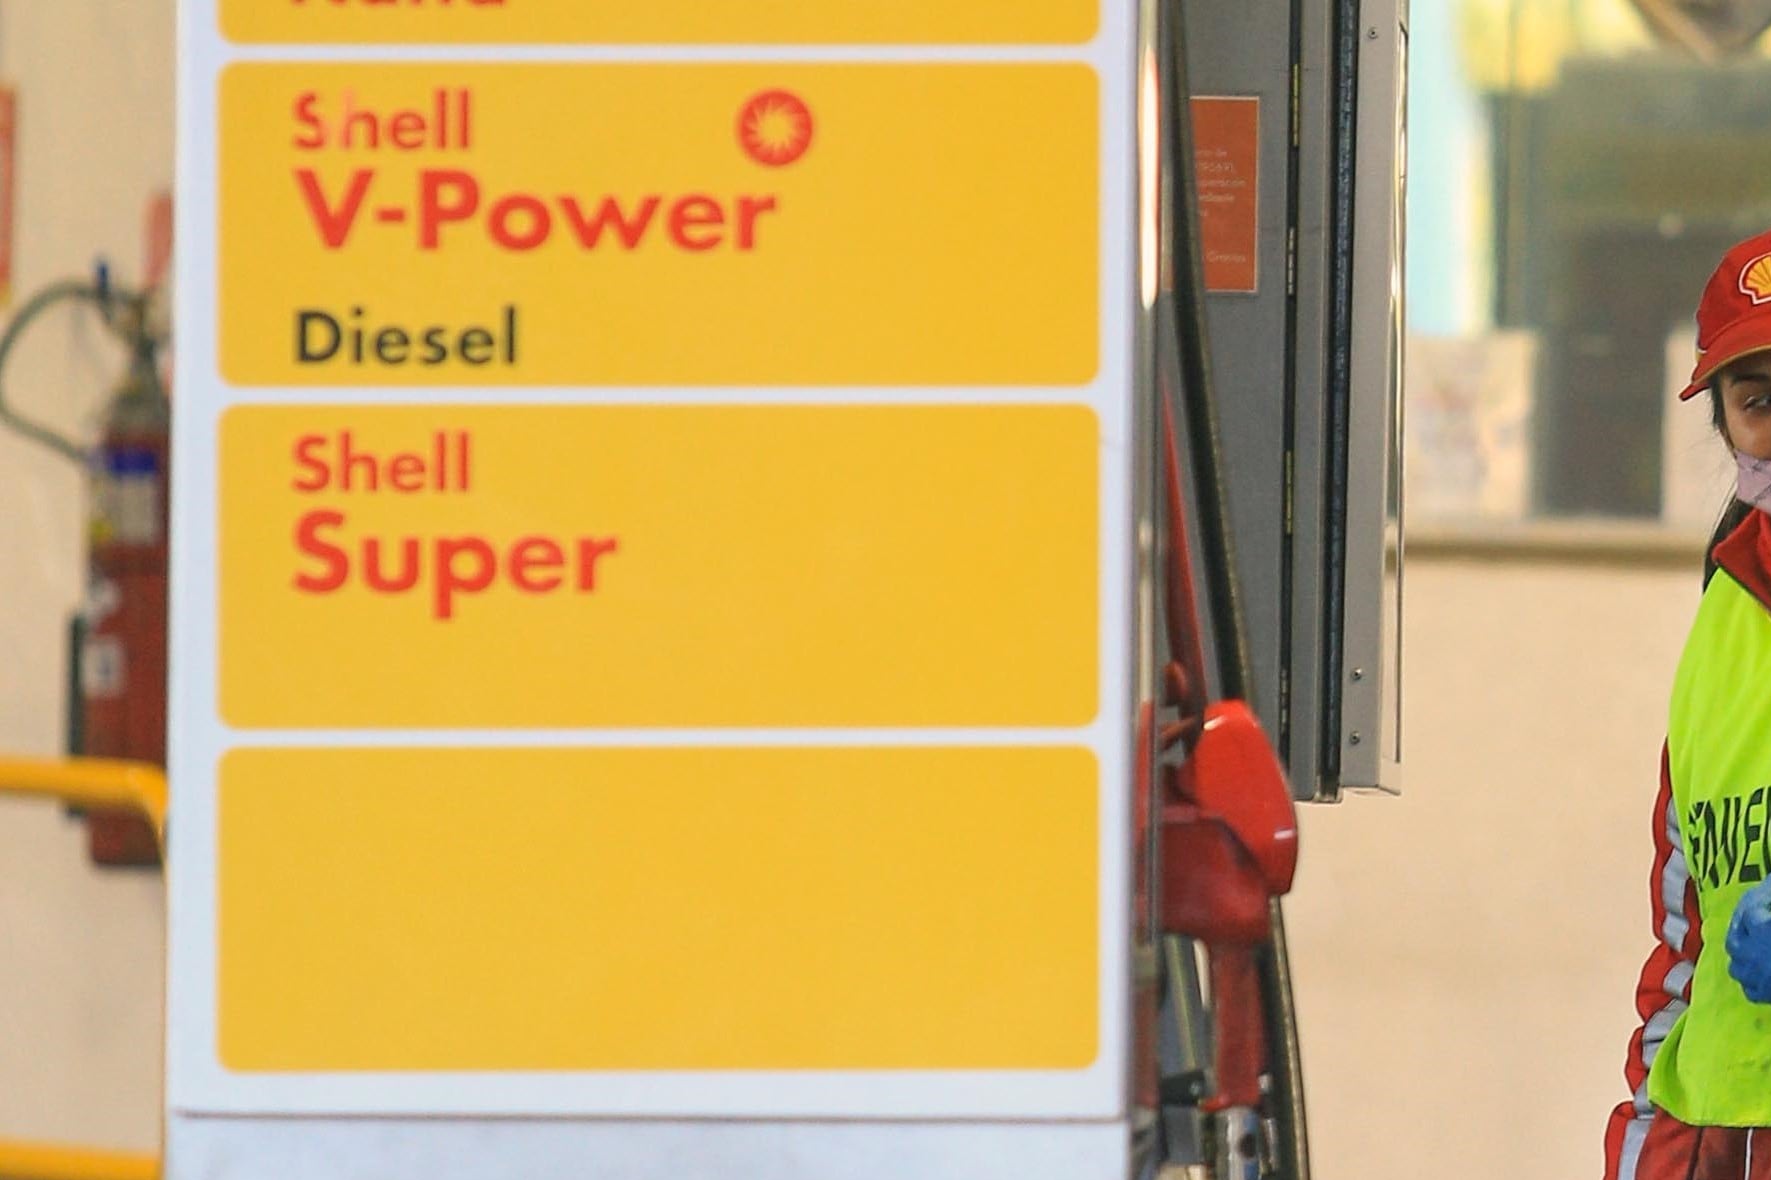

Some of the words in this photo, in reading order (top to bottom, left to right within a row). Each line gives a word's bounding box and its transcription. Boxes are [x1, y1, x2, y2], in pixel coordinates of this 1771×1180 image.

[293, 89, 471, 151] Shell
[294, 168, 778, 252] V-Power
[296, 305, 517, 365] Diesel
[293, 431, 470, 493] Shell
[293, 509, 618, 620] Super
